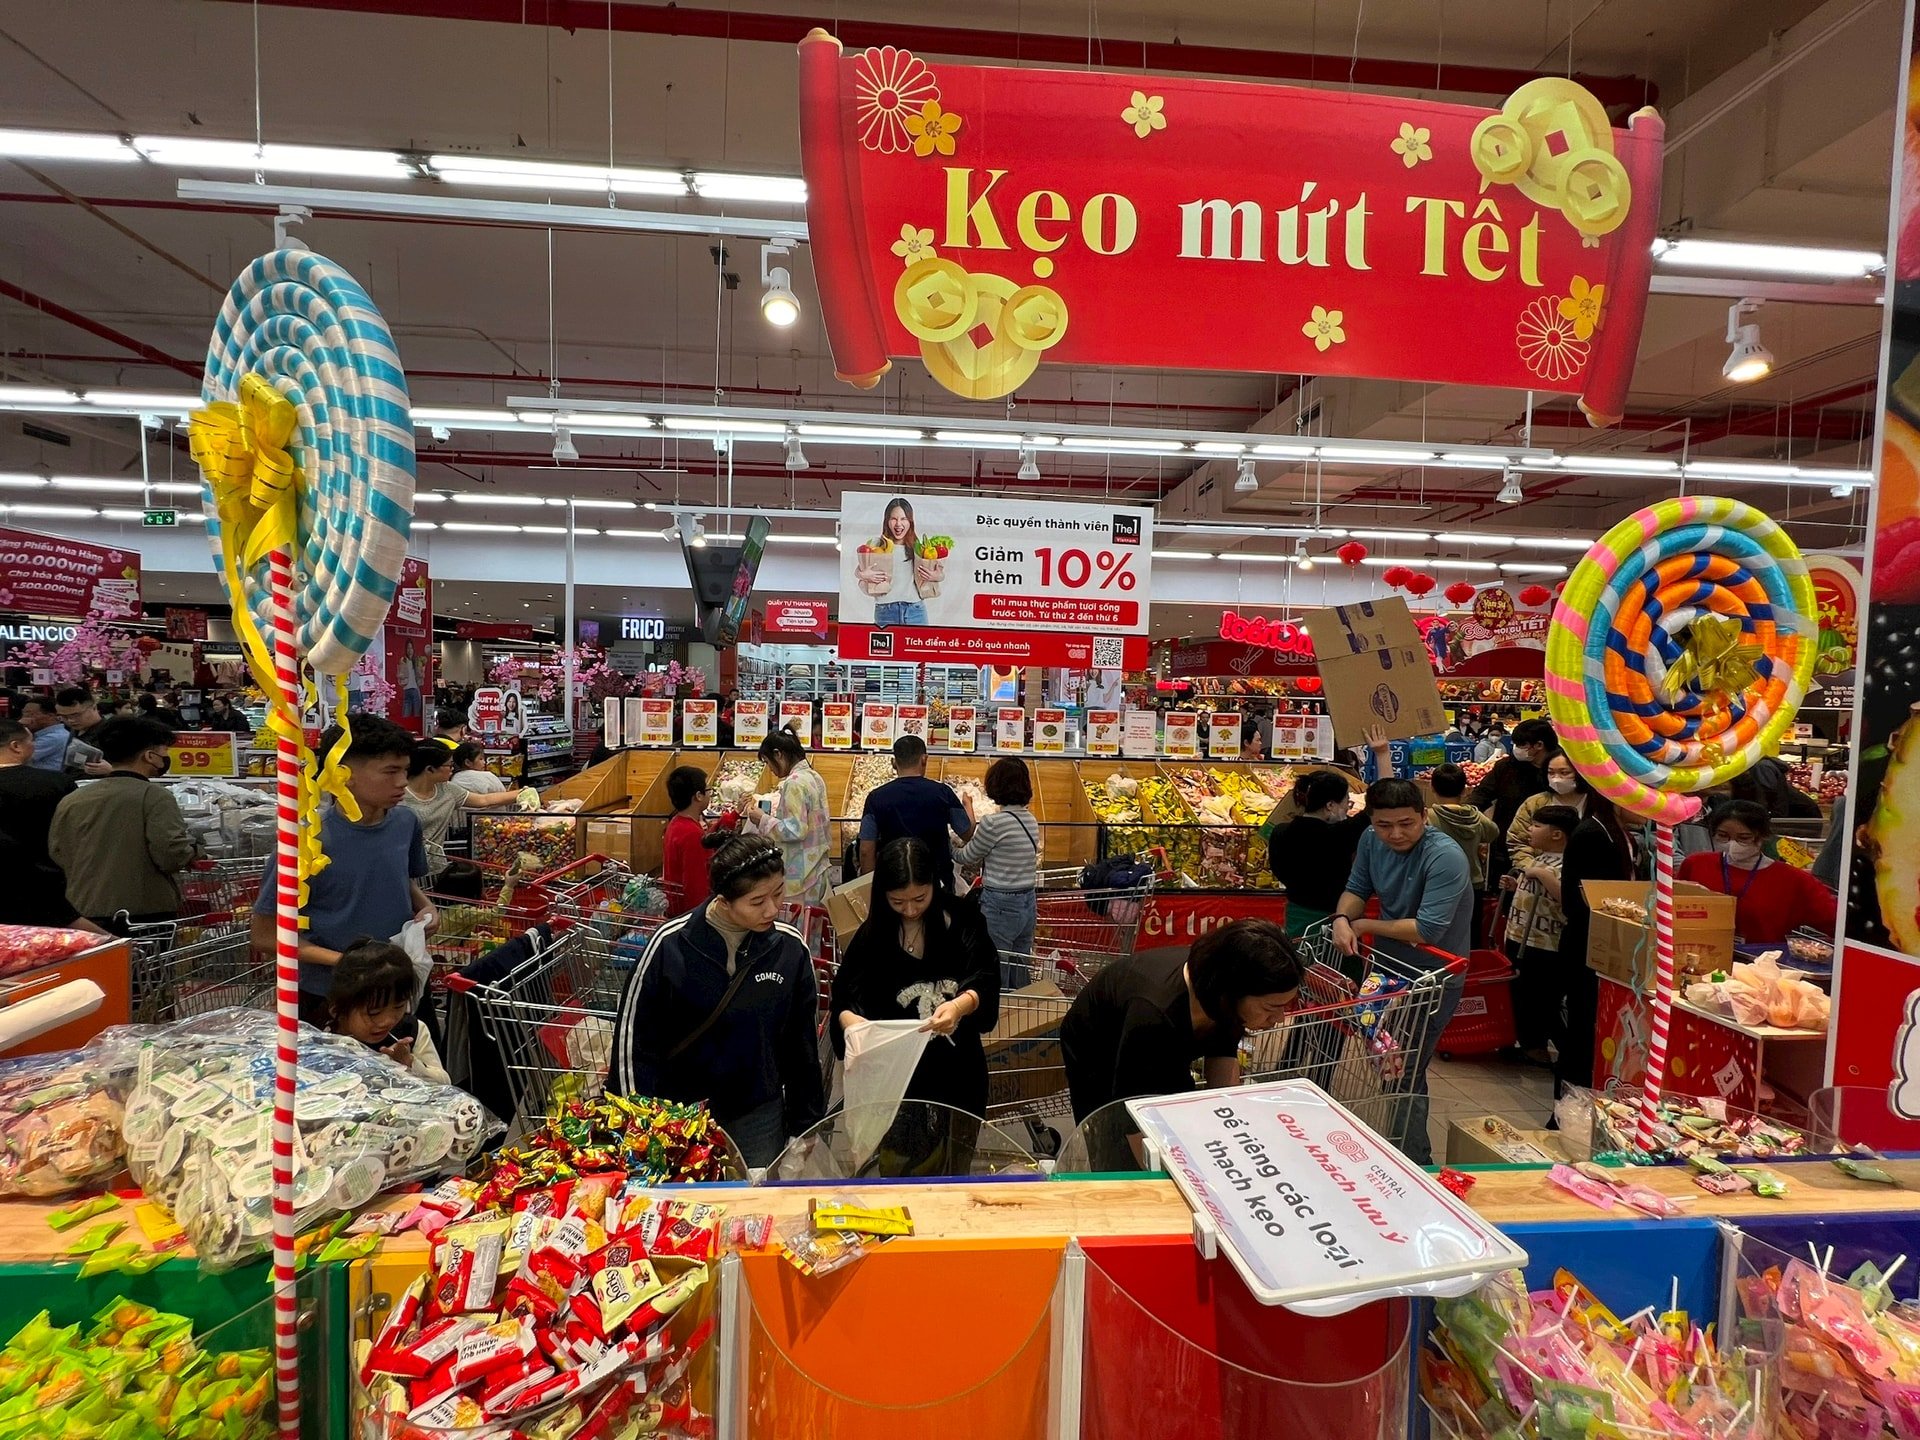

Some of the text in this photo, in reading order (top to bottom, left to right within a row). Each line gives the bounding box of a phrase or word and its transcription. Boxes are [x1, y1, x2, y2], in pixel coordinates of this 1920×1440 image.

[941, 167, 1137, 278] Kẹo
[1176, 182, 1373, 270] mứt
[976, 515, 1000, 528] Đặc
[1045, 517, 1080, 530] thành
[1084, 520, 1109, 532] viên
[55, 545, 77, 556] Mua
[78, 549, 104, 562] Hàng
[975, 545, 1024, 562] Giảm
[8, 570, 30, 578] Cho
[974, 568, 1023, 585] thêm
[1034, 547, 1136, 591] 10%
[991, 598, 1120, 613] Khi mua thực phẩm tươi sống
[992, 609, 1119, 622] trước 10h. Từ thứ 2 đến thứ 6
[622, 618, 664, 640] FRICO
[904, 637, 923, 646] Tích
[925, 636, 947, 647] điểm
[948, 638, 959, 648] dễ
[967, 638, 983, 648] Đổi
[985, 641, 1002, 651] quà
[1003, 642, 1031, 651] nhanh
[1824, 697, 1841, 706] 29
[179, 751, 211, 767] 99
[1142, 900, 1176, 936] ết
[755, 971, 784, 984] COMETS
[1170, 1145, 1188, 1164] Xin
[1183, 1168, 1208, 1197] cảm
[1276, 1113, 1409, 1244] Quý khách lưu ý
[1204, 1140, 1285, 1237] thạch kẹo
[1213, 1106, 1364, 1269] Để riêng các loại
[1365, 1173, 1394, 1200] RETAIL
[1370, 1164, 1407, 1199] CENTRAL
[606, 1269, 630, 1304] Korky
